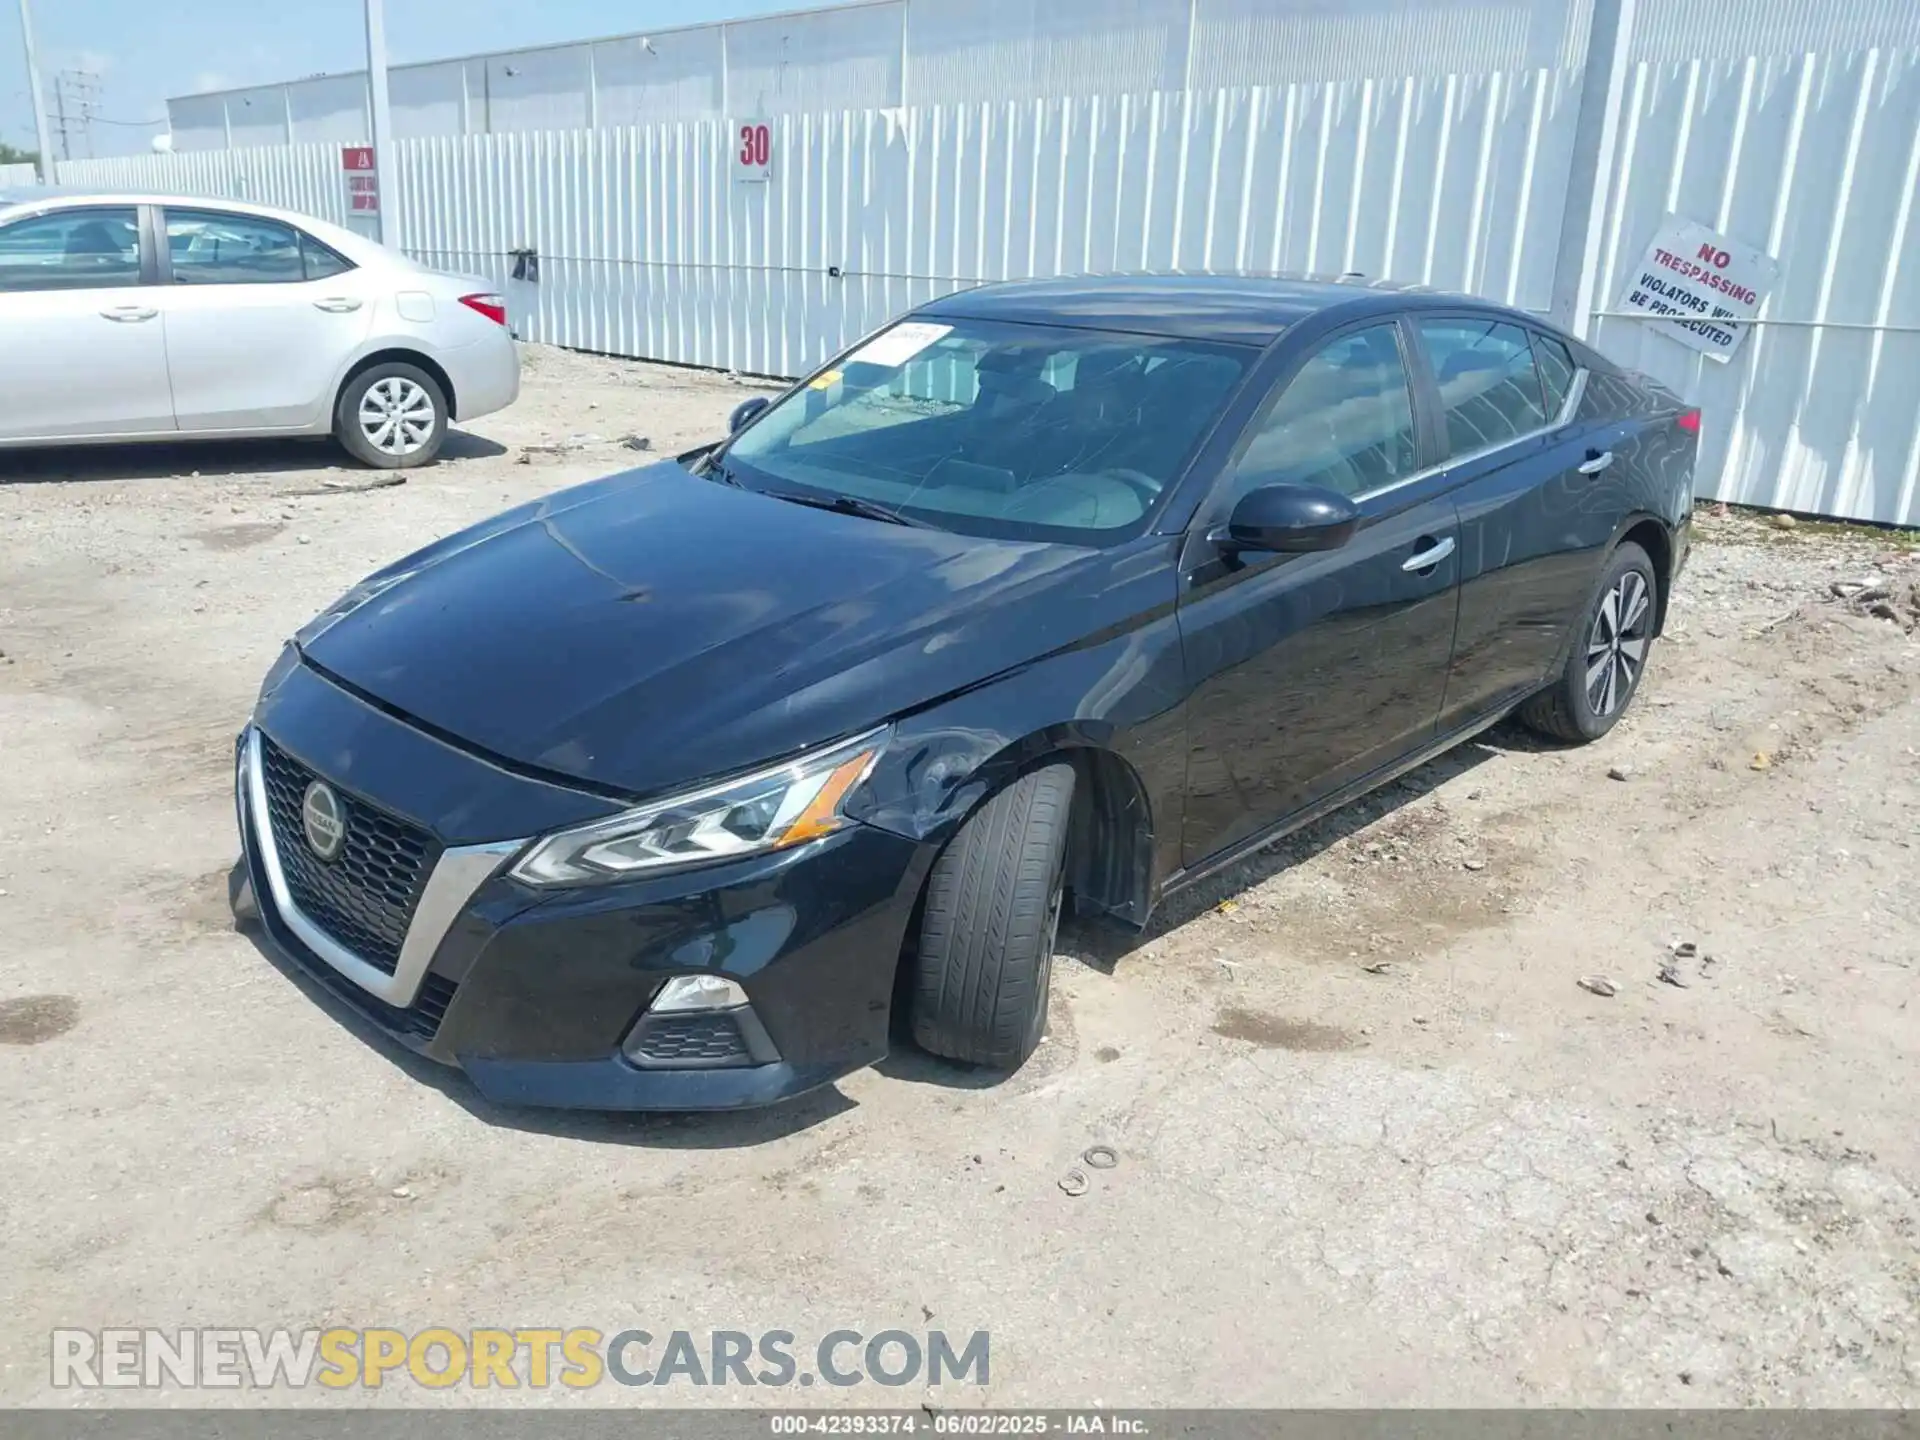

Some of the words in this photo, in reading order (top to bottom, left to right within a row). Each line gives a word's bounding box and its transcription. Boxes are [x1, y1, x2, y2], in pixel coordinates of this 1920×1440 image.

[740, 125, 769, 165] 30
[1696, 242, 1731, 269] NO
[1640, 272, 1709, 313] VIOLATORS
[1653, 248, 1757, 305] TRESPASSING
[1629, 290, 1649, 306] BE
